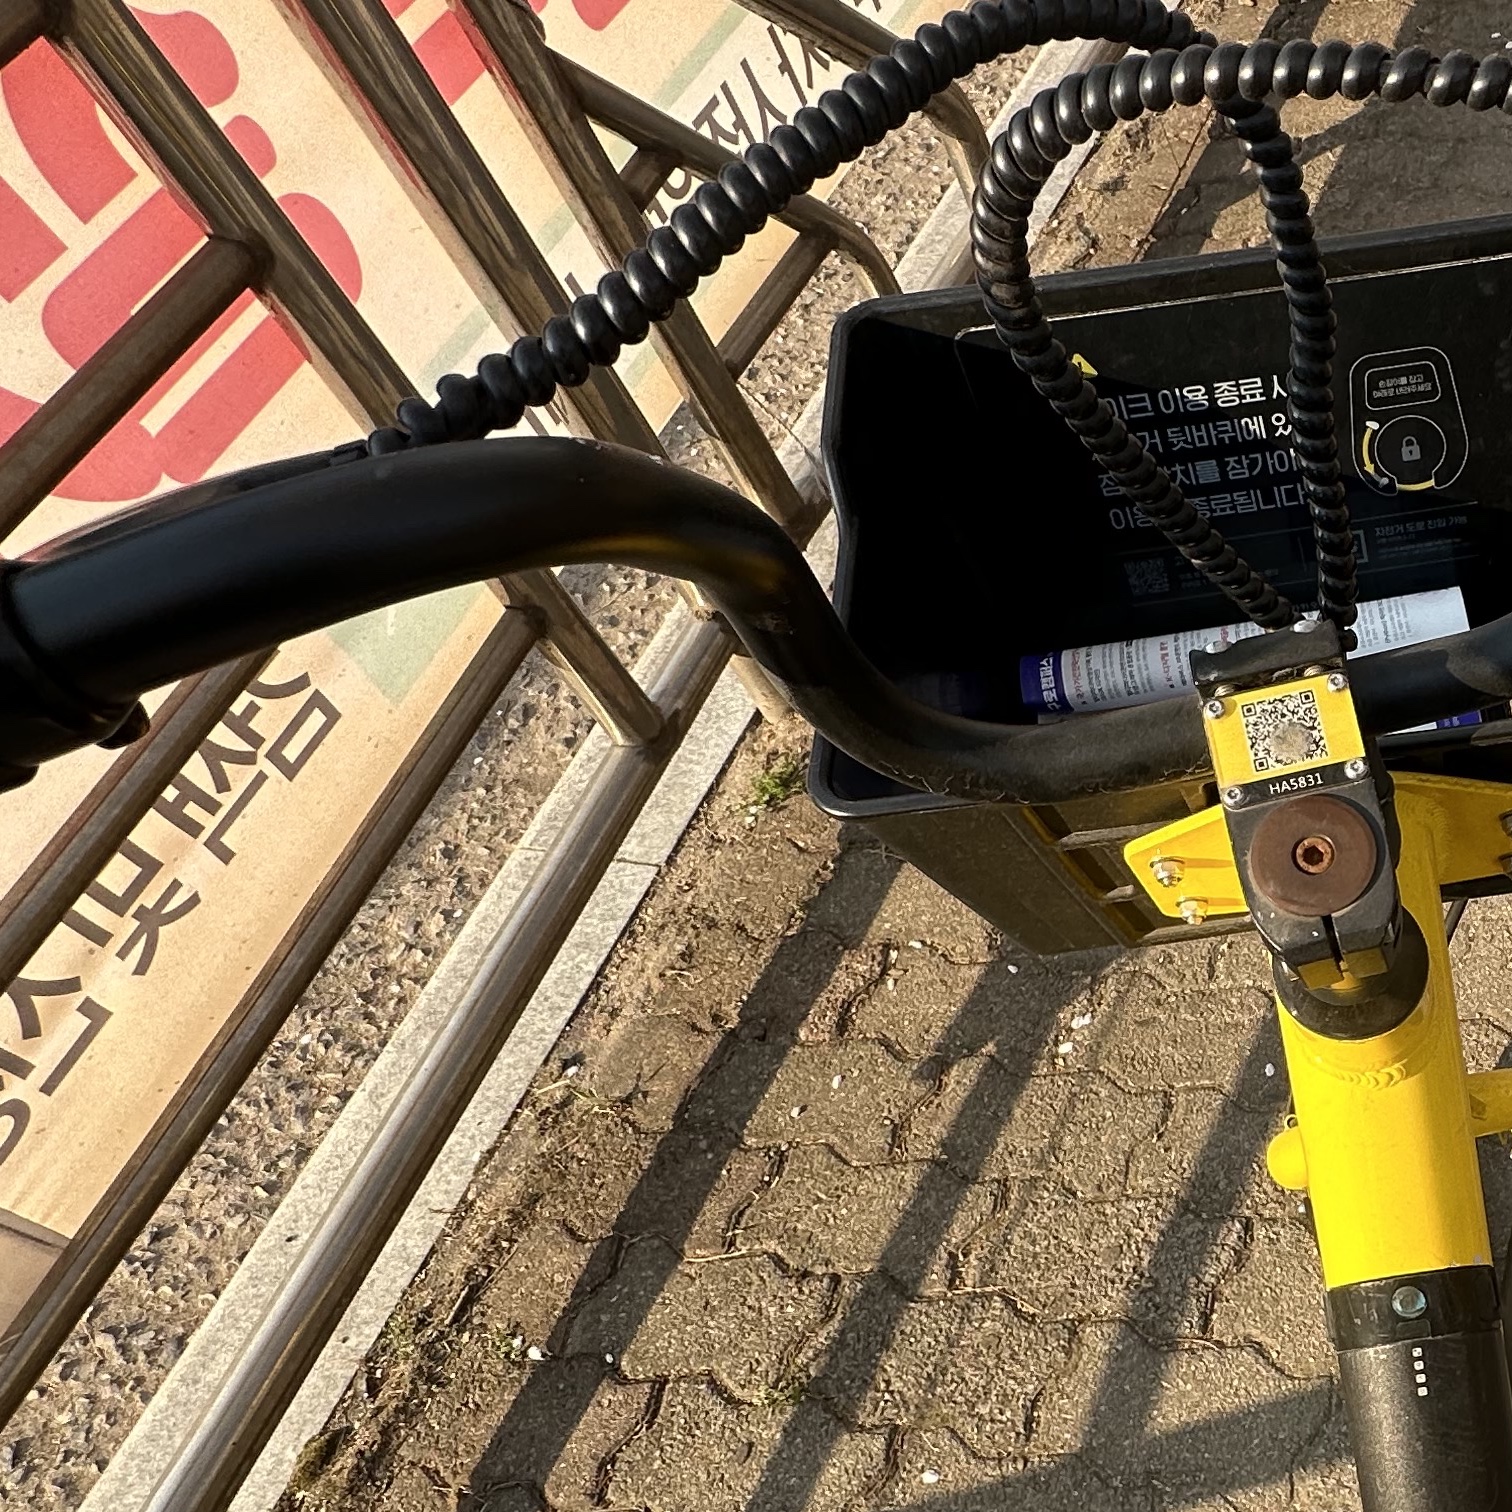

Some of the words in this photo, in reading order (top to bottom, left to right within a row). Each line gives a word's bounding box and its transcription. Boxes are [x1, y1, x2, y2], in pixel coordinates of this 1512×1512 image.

[1158, 385, 1209, 414] 이용
[1213, 377, 1266, 407] 종료
[1167, 415, 1267, 450] 뒷바퀴에
[1269, 772, 1324, 795] HA5831
